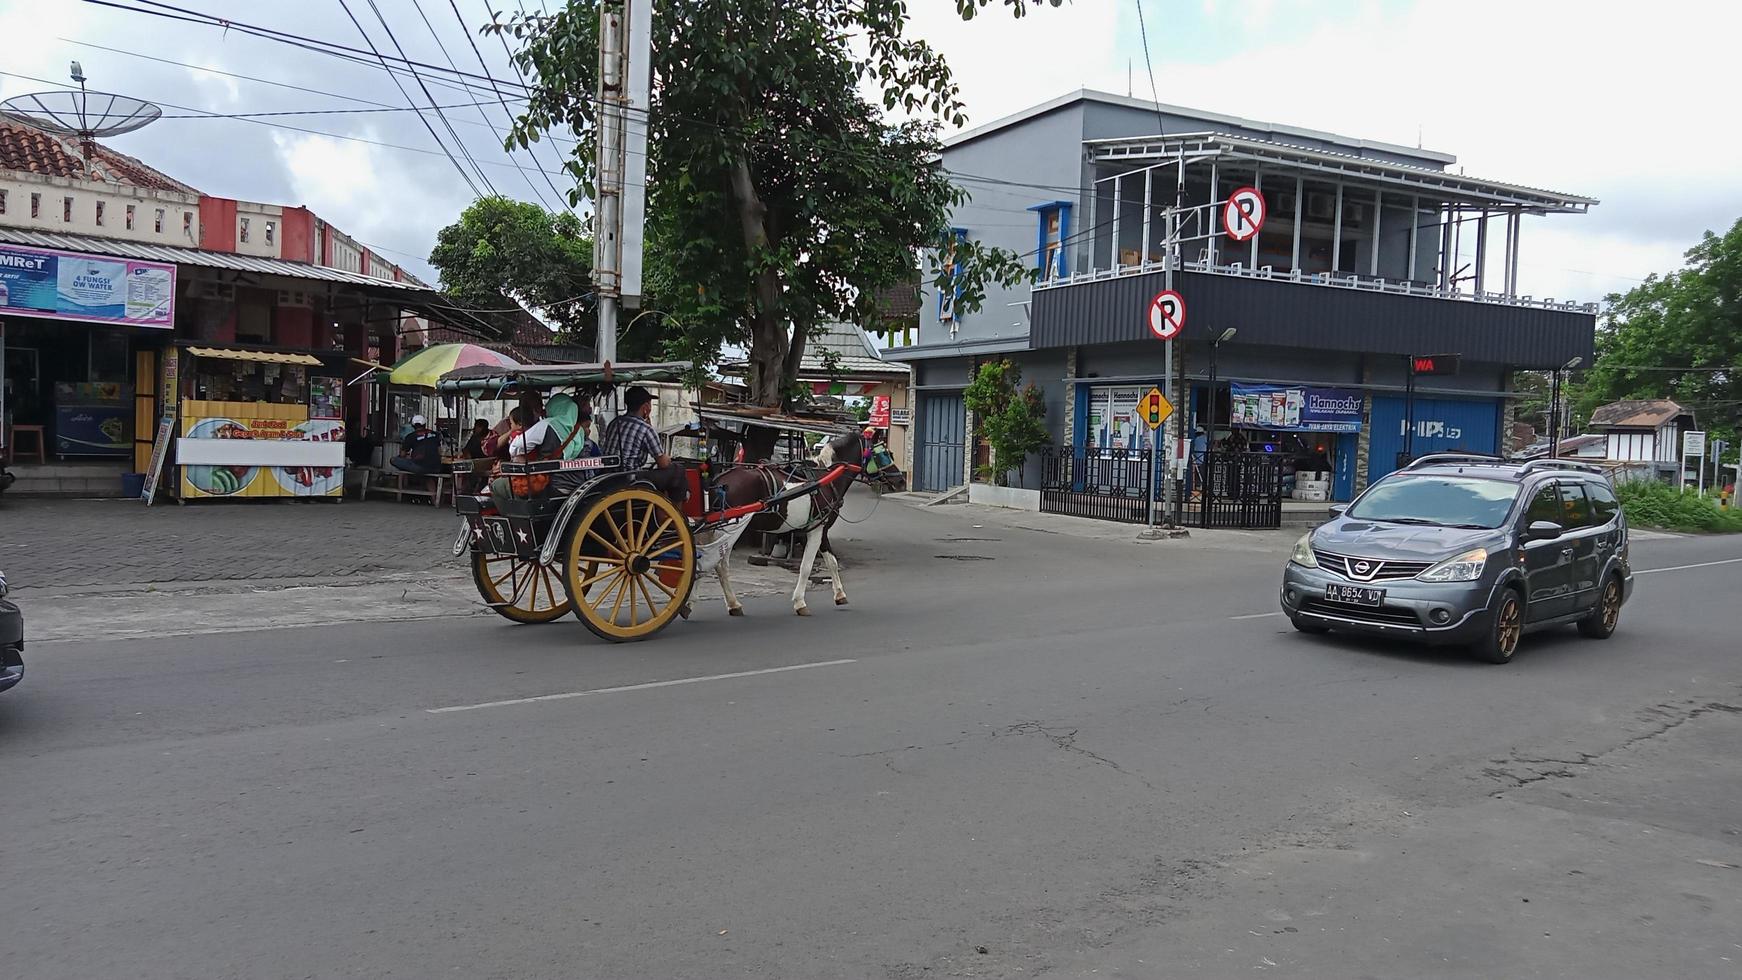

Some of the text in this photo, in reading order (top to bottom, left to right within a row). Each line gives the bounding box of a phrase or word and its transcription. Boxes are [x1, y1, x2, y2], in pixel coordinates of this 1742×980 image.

[88, 283, 112, 291] WATER
[1415, 359, 1434, 371] WA
[1308, 395, 1361, 411] Hannochs
[560, 459, 603, 468] IMANUEL
[1327, 585, 1337, 595] AA
[1341, 587, 1363, 598] 8654
